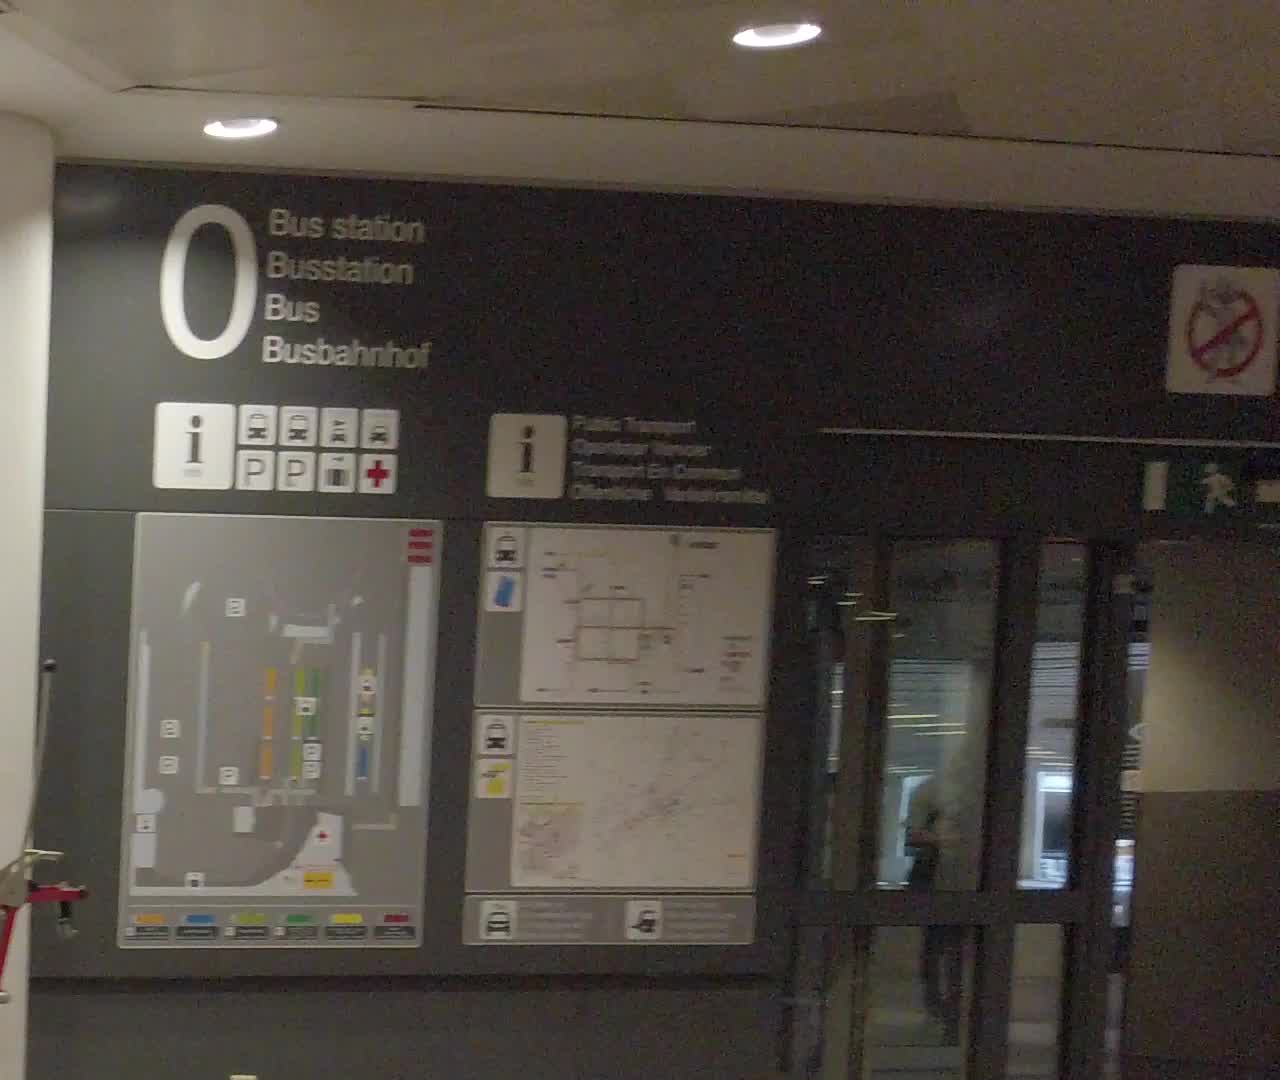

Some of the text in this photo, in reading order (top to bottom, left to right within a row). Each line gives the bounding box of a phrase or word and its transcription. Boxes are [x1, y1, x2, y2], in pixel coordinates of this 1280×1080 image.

[269, 208, 425, 244] Bus station
[266, 249, 416, 286] Busstation
[263, 293, 321, 324] Bus
[261, 335, 433, 370] Busbahnhof
